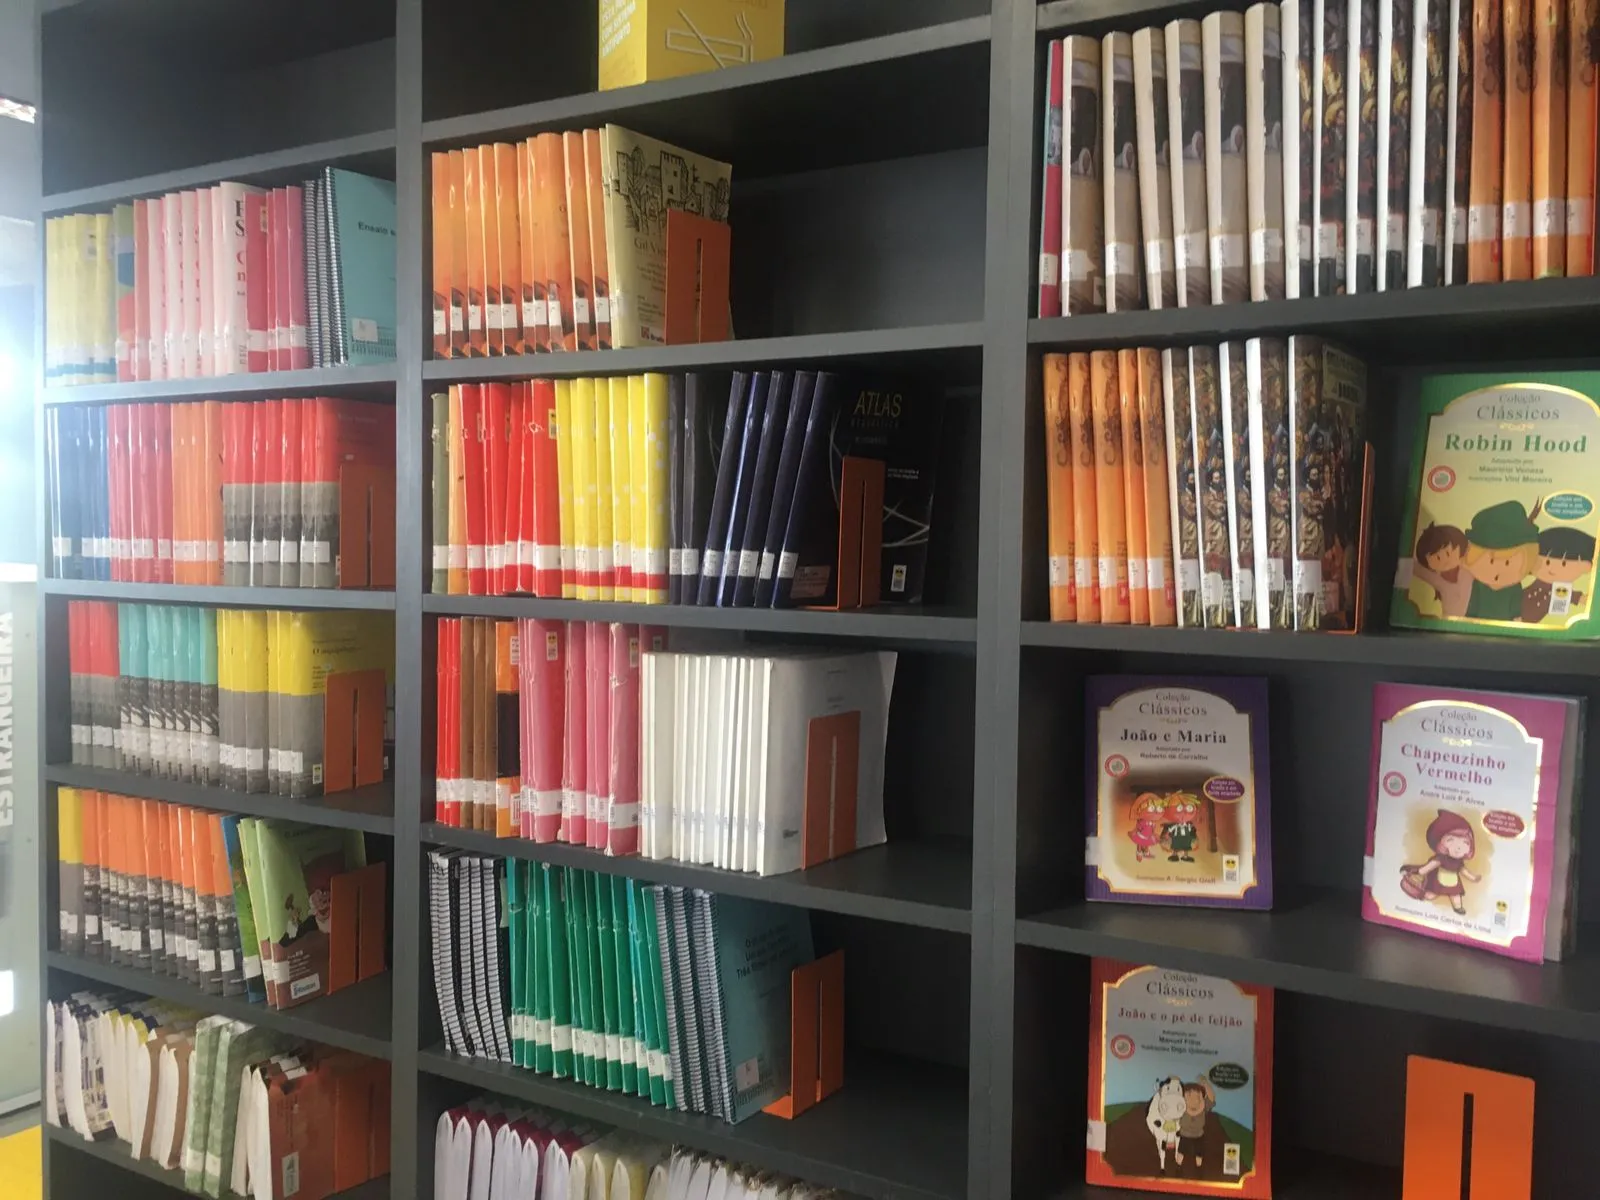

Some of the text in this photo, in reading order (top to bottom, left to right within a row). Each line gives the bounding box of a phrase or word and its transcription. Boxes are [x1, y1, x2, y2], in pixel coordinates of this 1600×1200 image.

[853, 390, 903, 418] ATLAS
[1499, 393, 1541, 403] Coleção
[1477, 405, 1560, 421] Clássicos
[1445, 433, 1588, 453] Robin Hood
[1156, 692, 1191, 703] Coleção
[1139, 702, 1208, 716] Clássicos
[1440, 708, 1477, 723] Coleção
[1120, 728, 1227, 744] João e Maria
[1421, 718, 1494, 740] Clássicos
[1401, 743, 1507, 771] Chapeuzinho
[1415, 762, 1493, 787] Vermelho
[1163, 972, 1198, 984] Coleção
[1146, 981, 1215, 999] Clássicos
[1118, 1007, 1243, 1028] João e o pé de feijão
